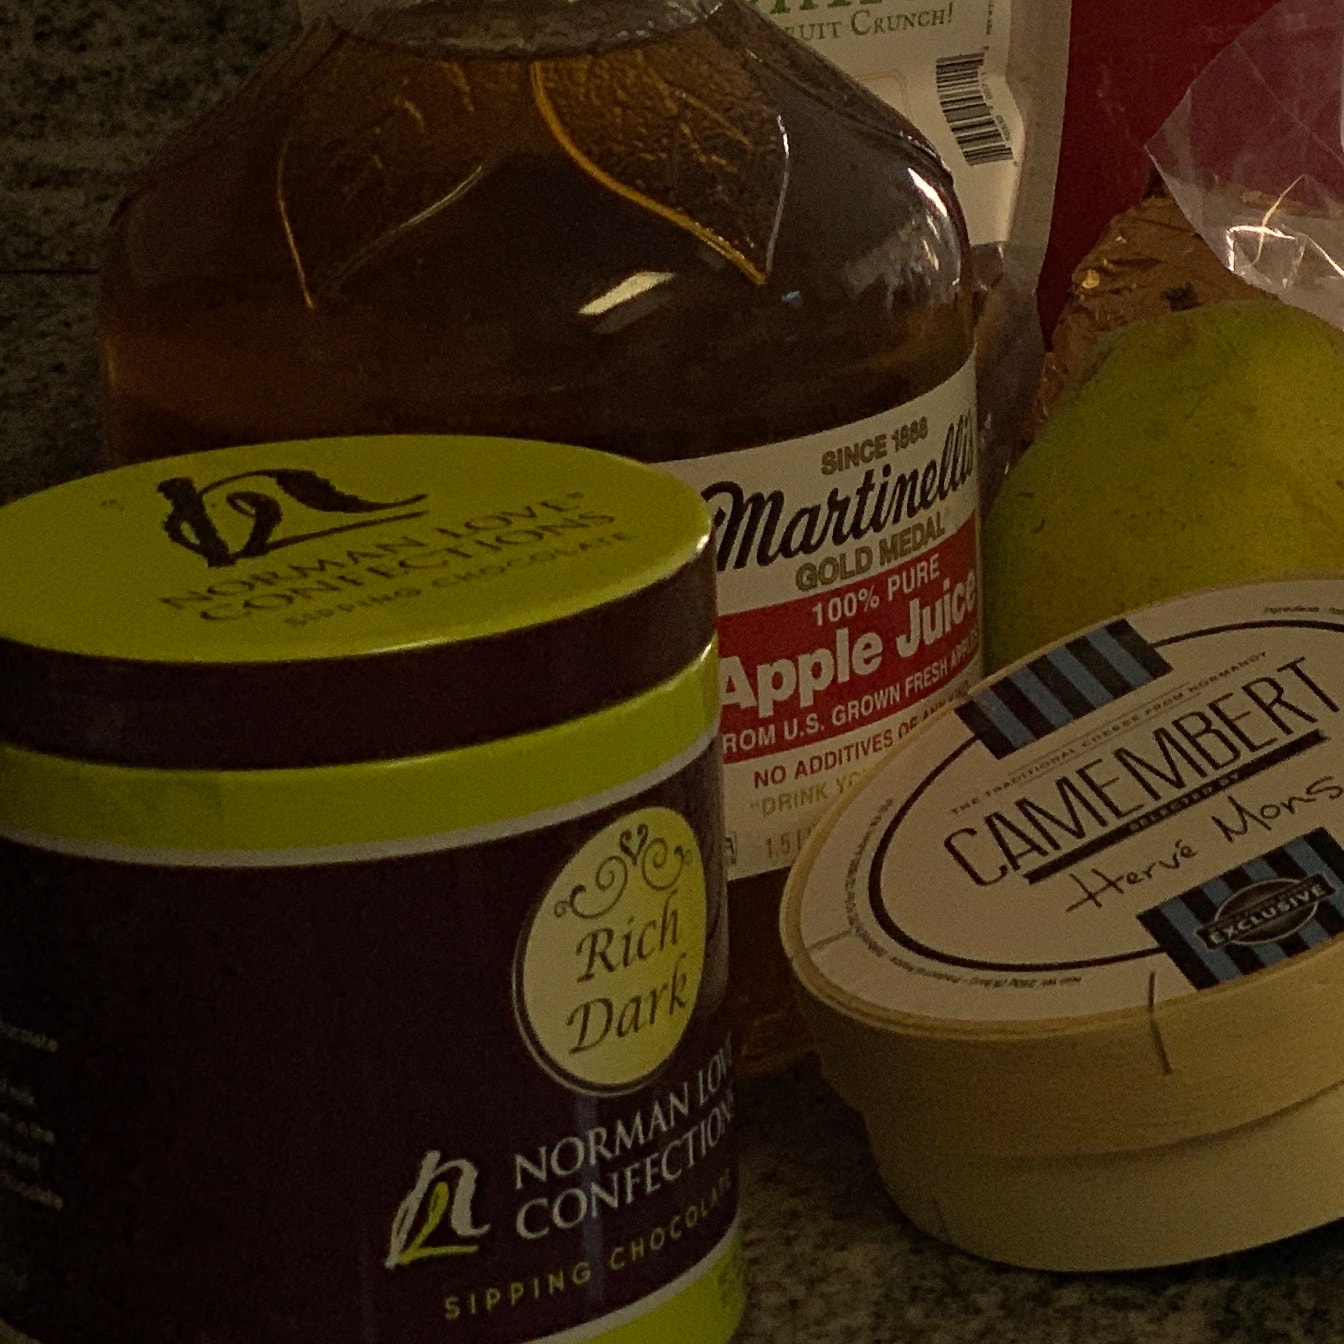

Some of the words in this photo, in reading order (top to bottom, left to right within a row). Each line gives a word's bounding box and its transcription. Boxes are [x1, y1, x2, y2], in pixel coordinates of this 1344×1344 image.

[851, 2, 953, 35] CRUNCH!
[821, 433, 887, 476] SINCE
[161, 536, 427, 610] NORMAN
[436, 494, 574, 539] LOVE
[201, 510, 616, 622] CONFECTIONS
[795, 547, 872, 592] GOLD
[879, 523, 944, 570] MEDAL
[812, 584, 880, 628] 100%
[887, 554, 940, 599] PURE
[719, 627, 883, 718] Apple
[896, 568, 977, 659] Juice
[720, 724, 776, 754] ROM
[783, 714, 824, 741] U.S.
[831, 683, 901, 727] GROWN
[904, 654, 949, 699] FRESH
[754, 765, 786, 789] NO
[795, 729, 893, 780] ADDITIVES
[944, 657, 1340, 887] CAMEMBERT
[1066, 839, 1200, 914] Hervé
[1211, 773, 1344, 844] Mons
[576, 890, 682, 984] Rich
[1210, 883, 1327, 946] EXCLUSIVE
[566, 955, 689, 1057] Dark
[513, 1083, 690, 1192] NORMAN
[444, 1260, 592, 1322] SIPPING
